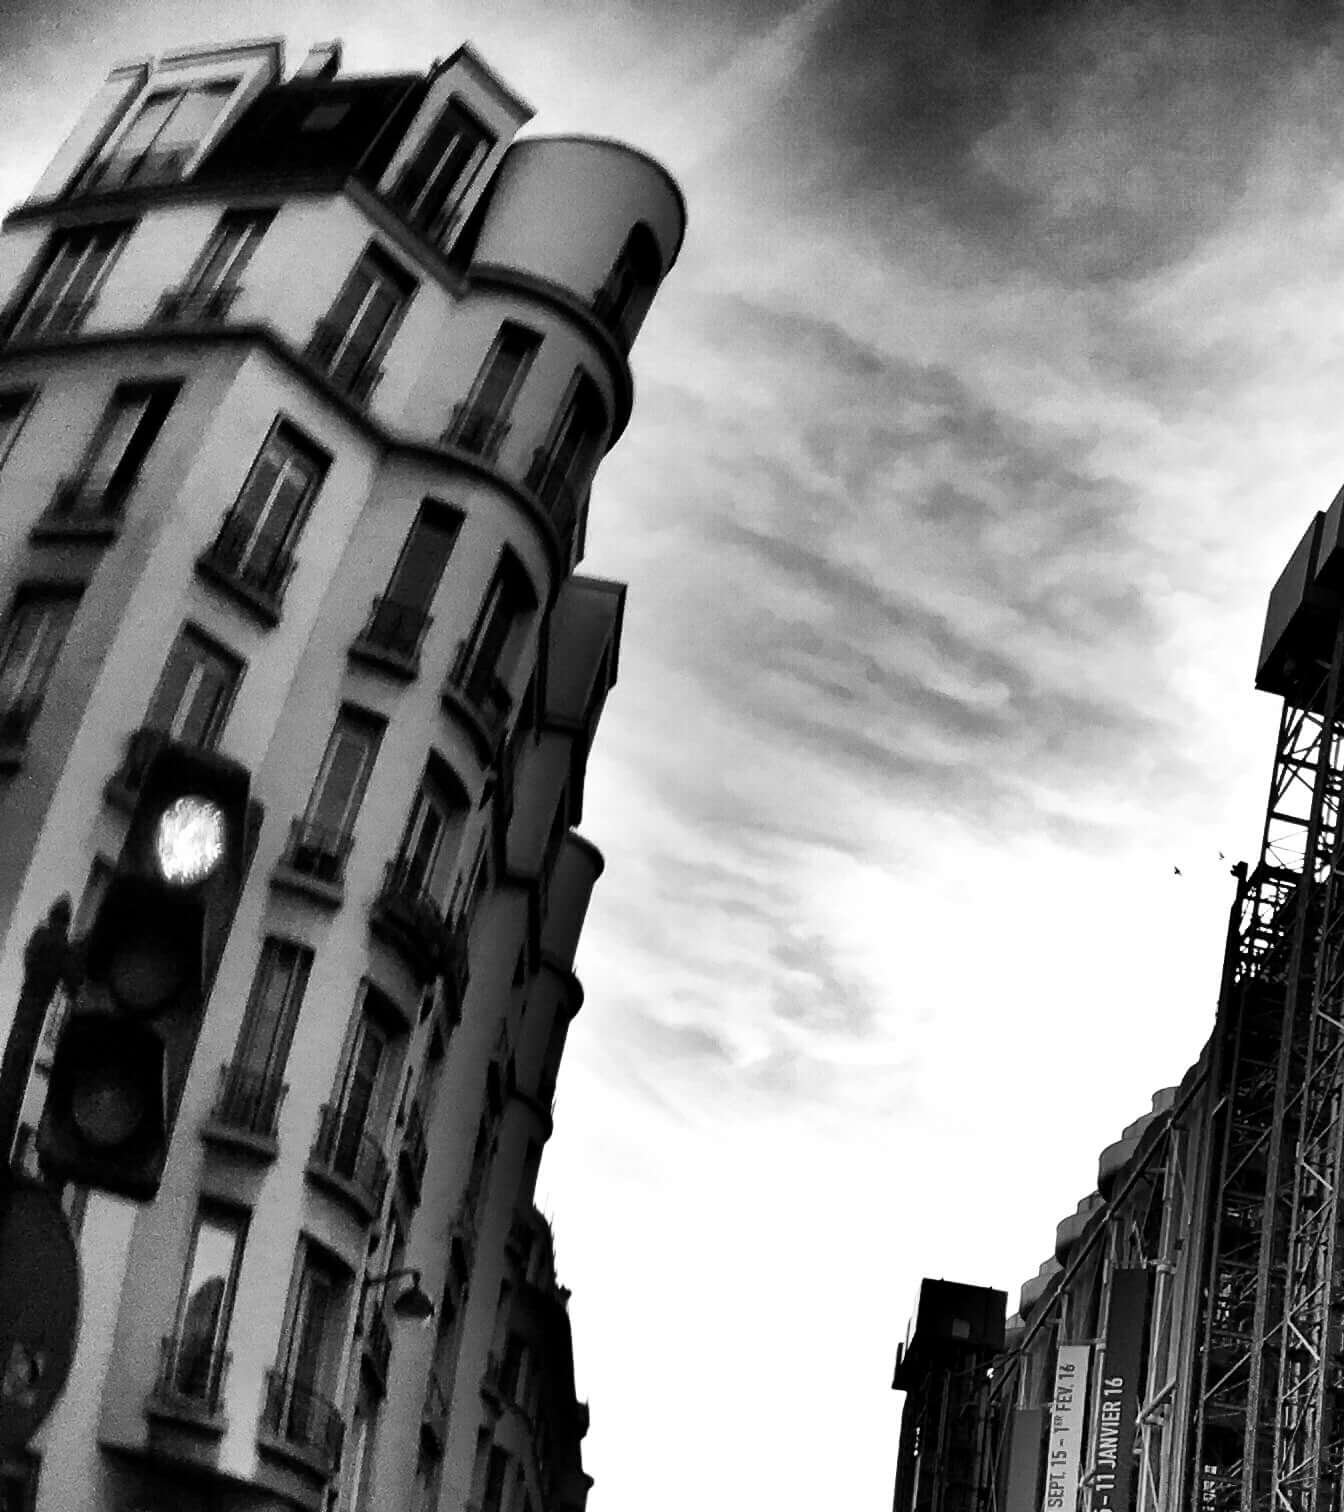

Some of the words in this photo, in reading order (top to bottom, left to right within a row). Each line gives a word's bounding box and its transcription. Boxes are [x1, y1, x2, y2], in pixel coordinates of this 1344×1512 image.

[1058, 1363, 1077, 1381] 16
[1103, 1375, 1124, 1396] 16
[1096, 1400, 1123, 1471] JANVIER
[1050, 1450, 1067, 1467] 15
[1095, 1472, 1115, 1493] 11
